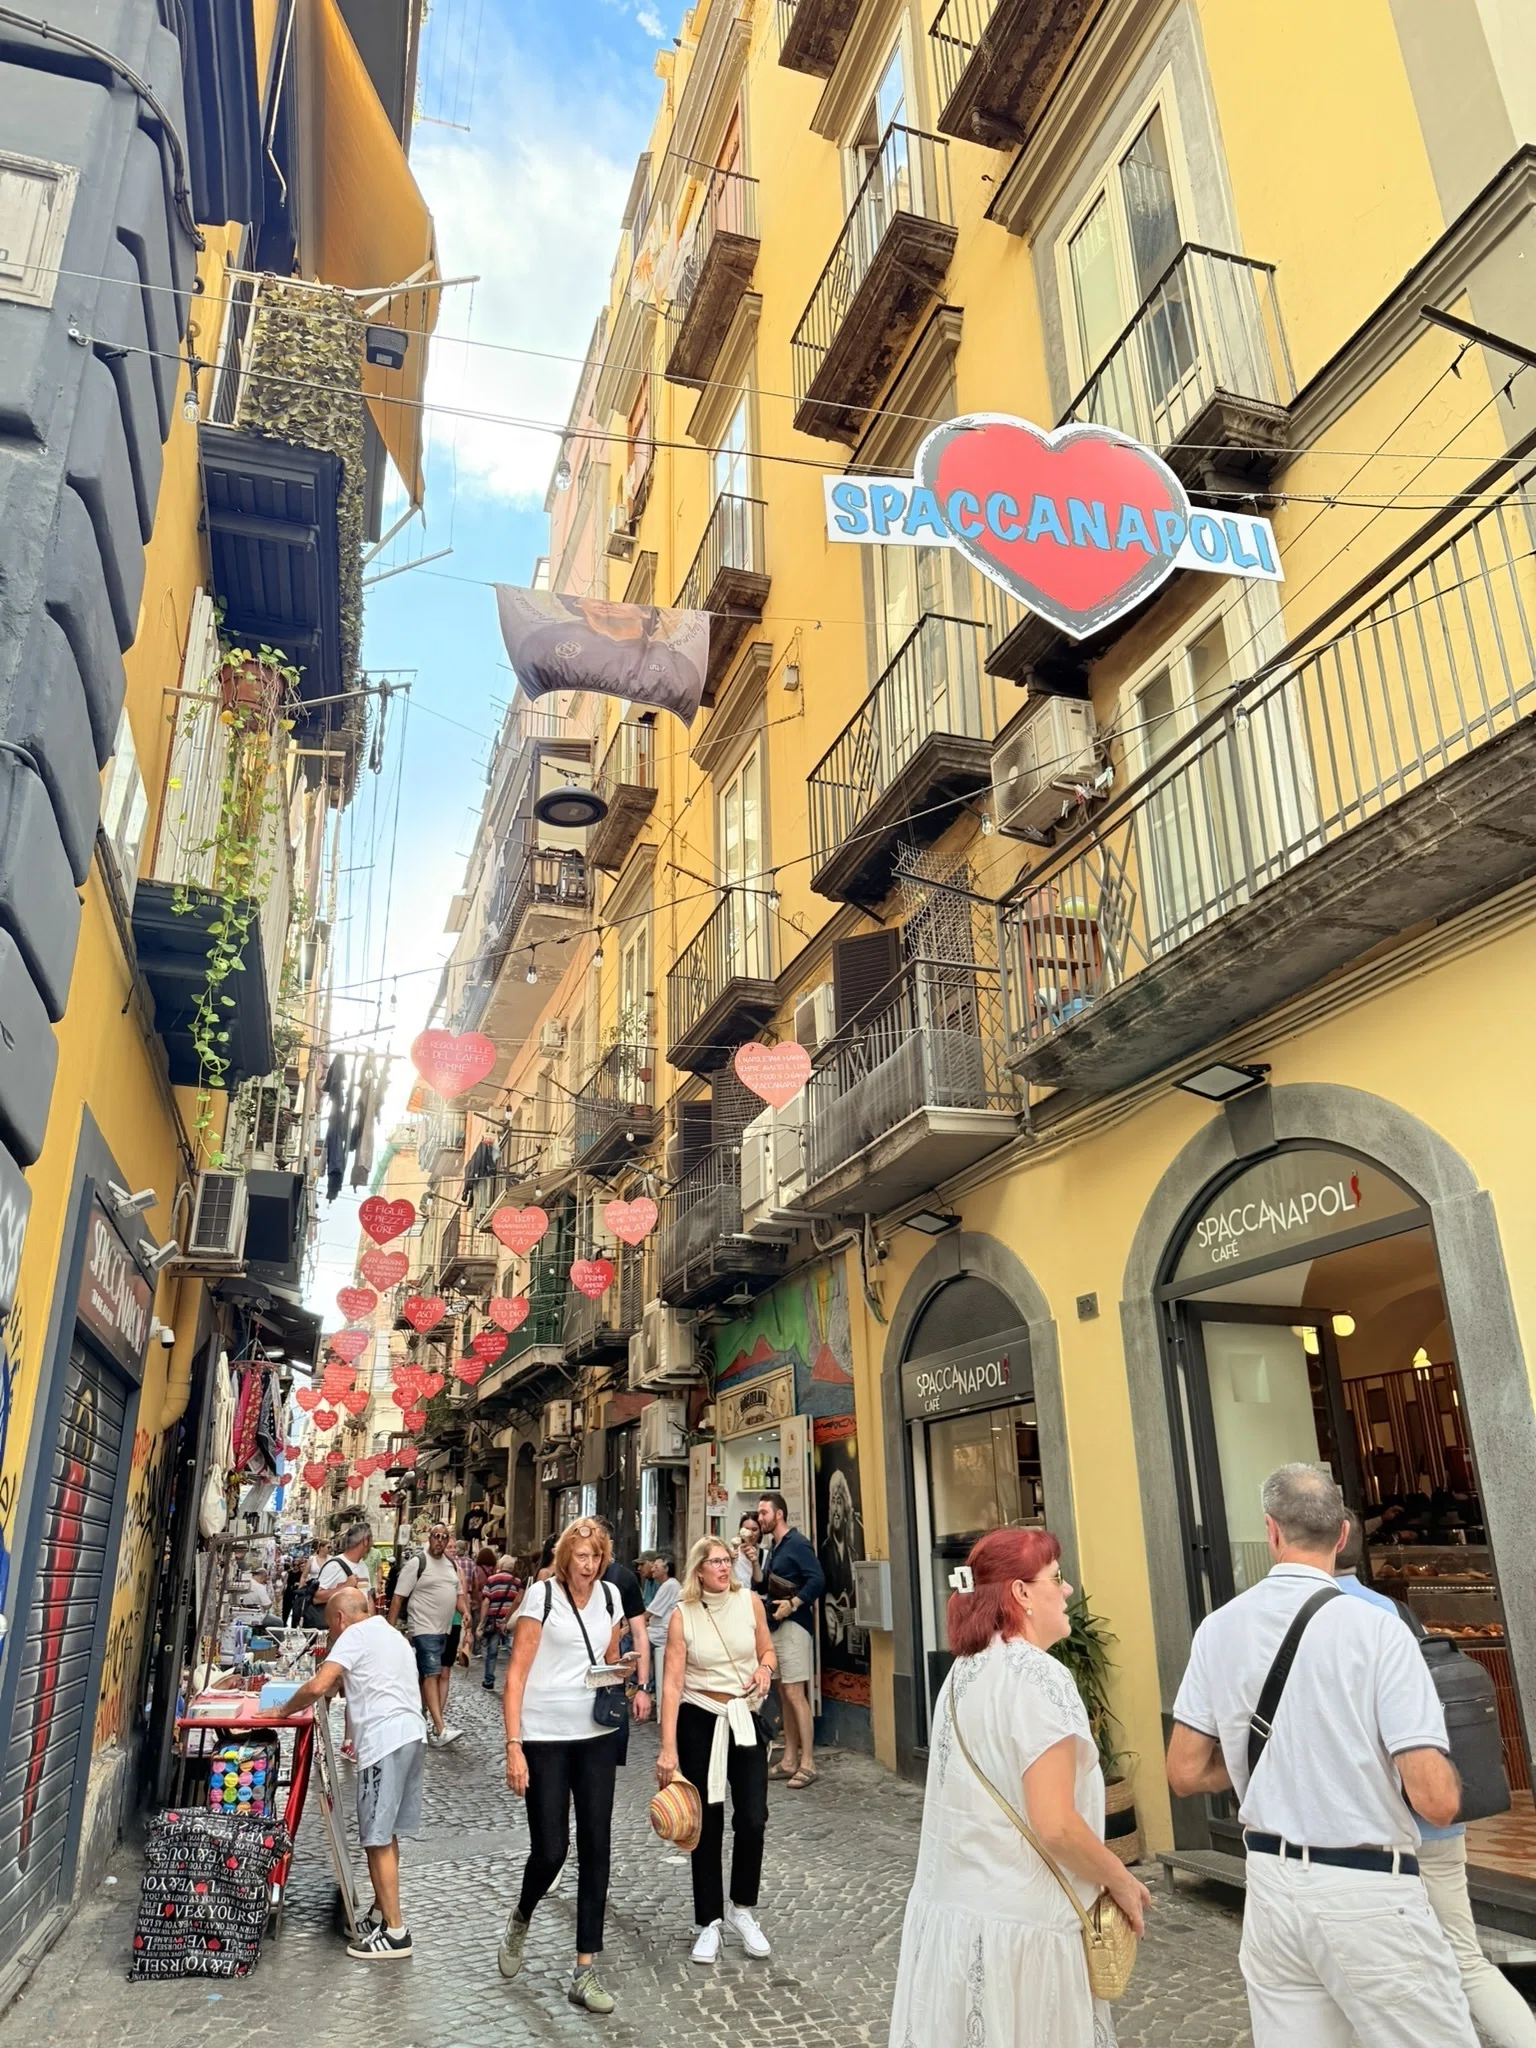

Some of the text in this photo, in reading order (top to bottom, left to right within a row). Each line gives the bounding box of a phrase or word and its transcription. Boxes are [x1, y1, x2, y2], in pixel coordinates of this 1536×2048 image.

[832, 483, 1276, 573] SPACCANAPOLI
[430, 1041, 461, 1050] REGOLE
[465, 1045, 491, 1054] DELLE
[432, 1050, 448, 1059] DEL
[435, 1061, 469, 1072] COMME
[375, 1204, 408, 1217] FIGLIE
[1211, 1239, 1241, 1263] CAFÉ
[924, 1395, 941, 1412] CAFÉ
